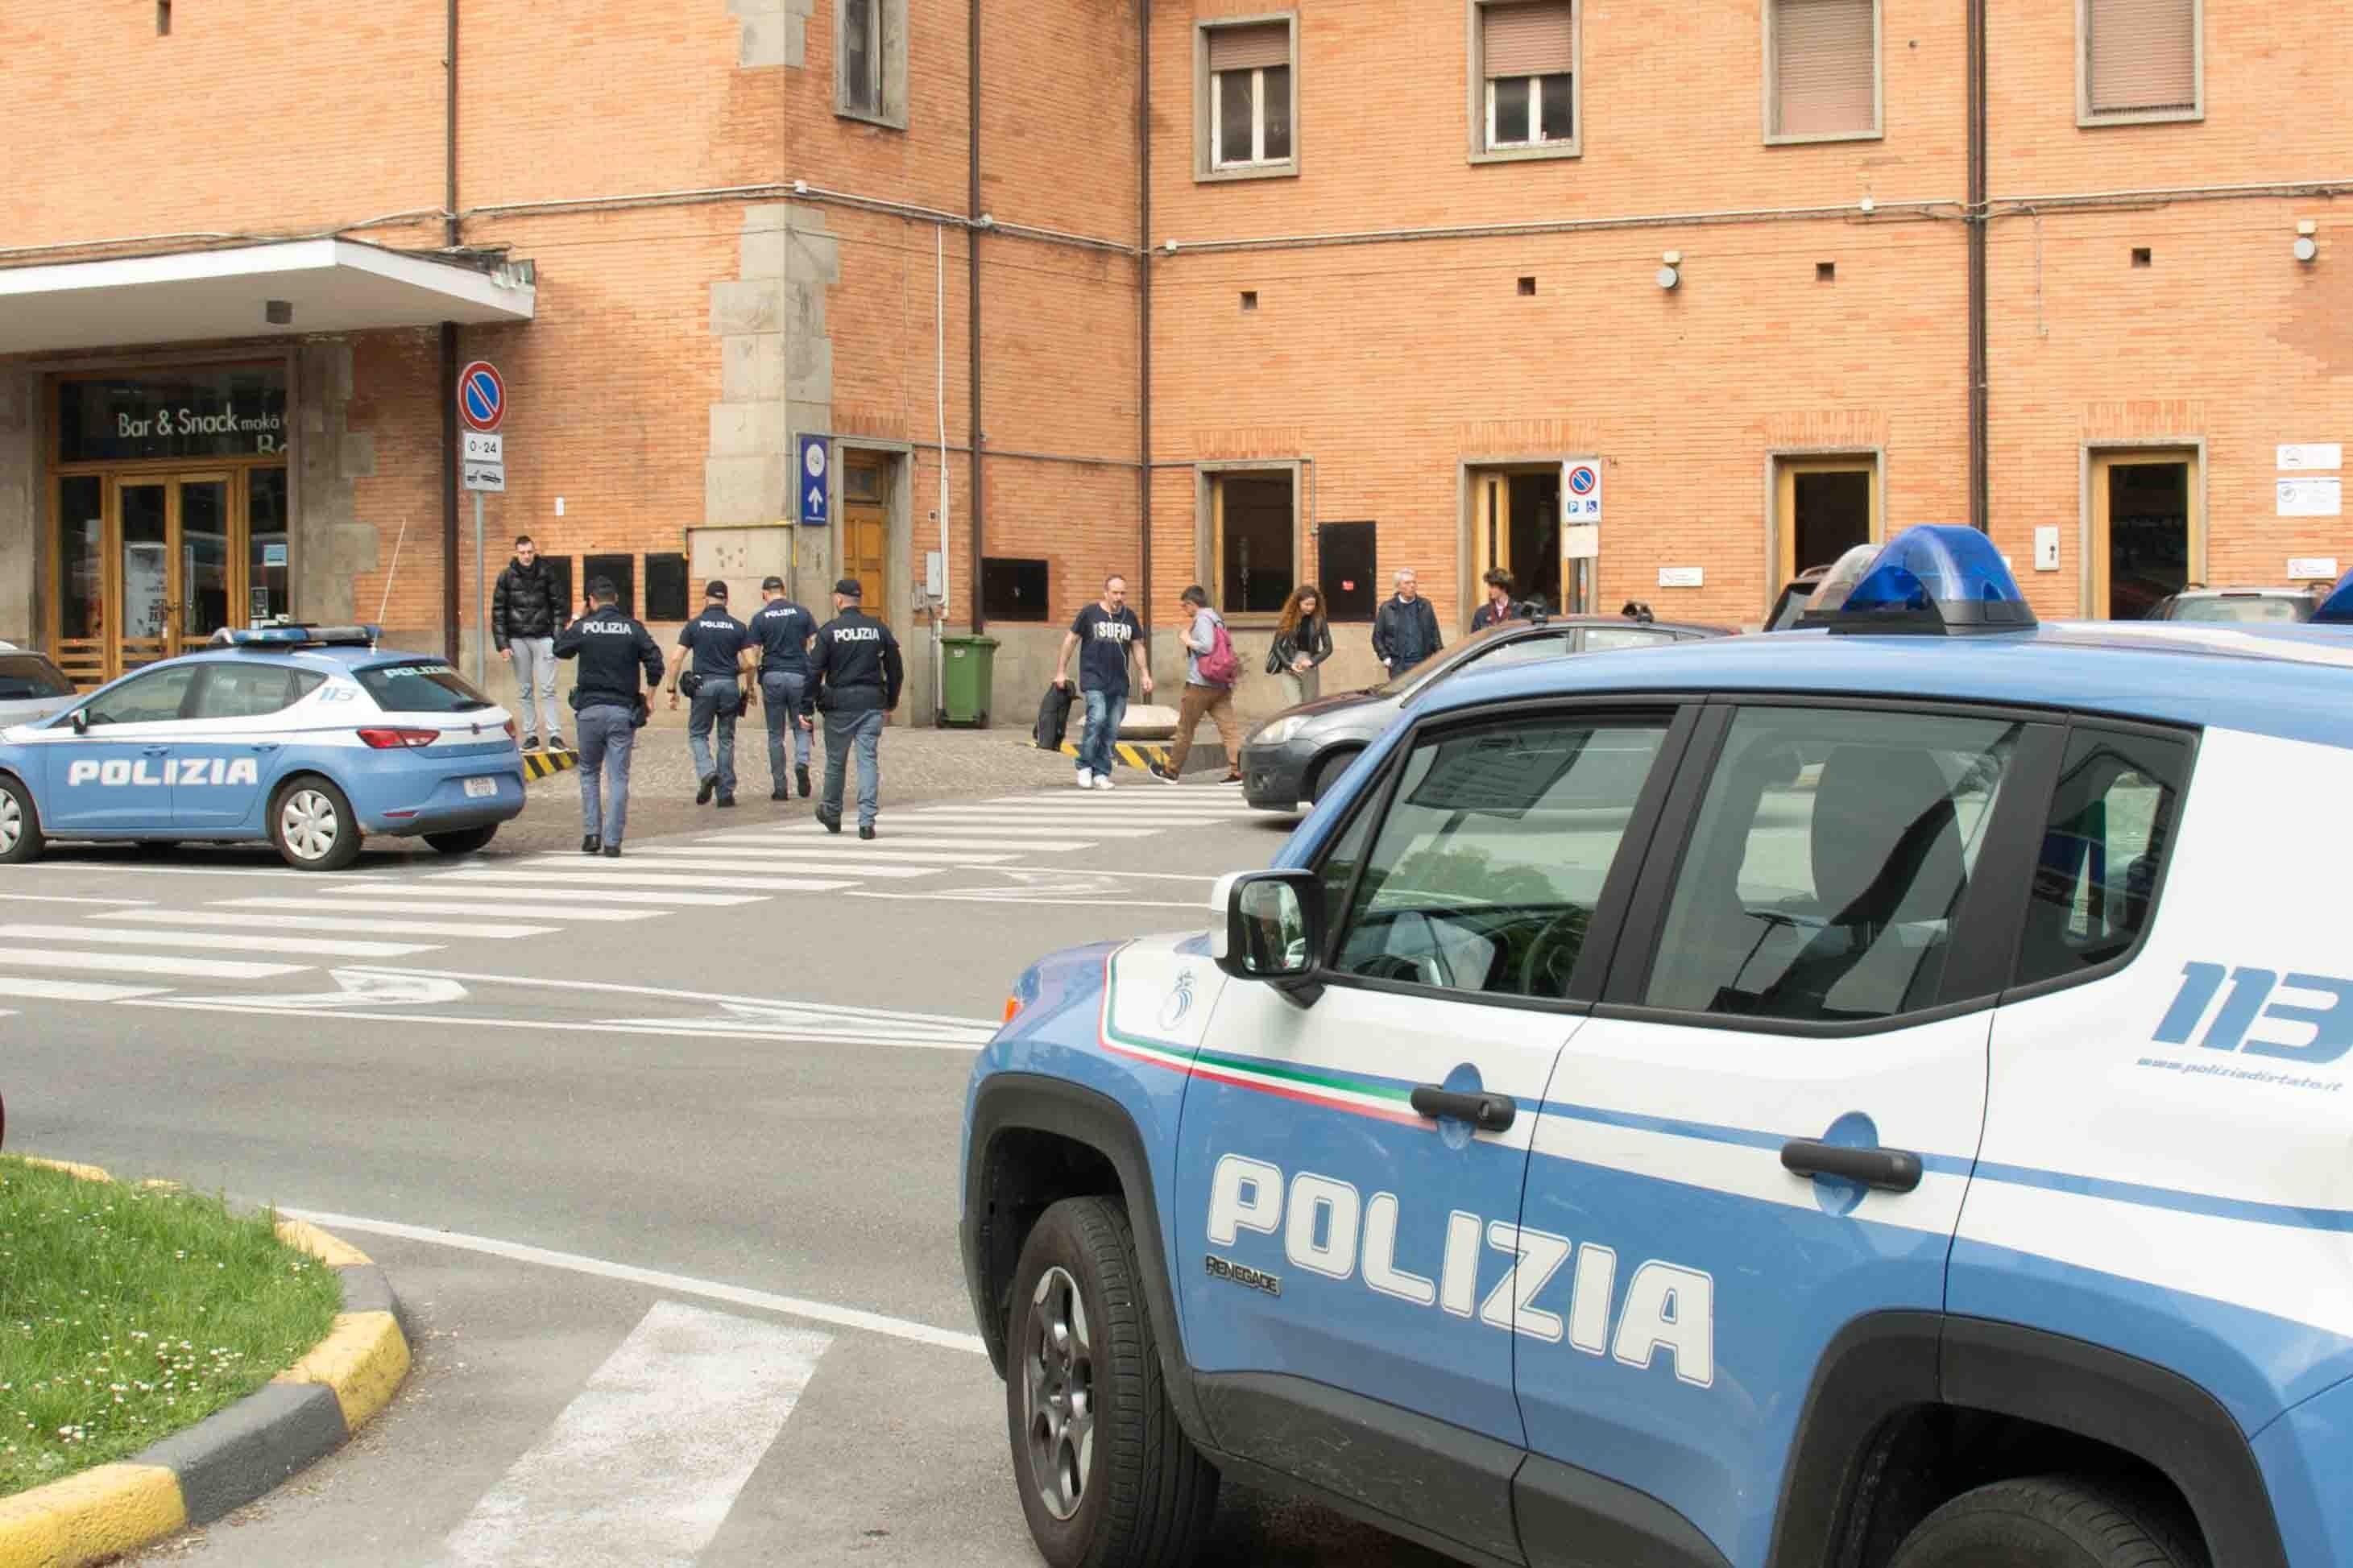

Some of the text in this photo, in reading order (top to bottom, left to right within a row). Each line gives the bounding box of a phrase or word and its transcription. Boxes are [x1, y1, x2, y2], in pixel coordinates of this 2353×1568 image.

[118, 412, 152, 437] Bar
[157, 409, 174, 436] &
[178, 402, 238, 435] Snack
[582, 620, 632, 635] POLIZIA
[700, 620, 734, 631] POLIZIA
[764, 607, 797, 619] POLIZIA
[834, 627, 880, 643] POLIZIA
[67, 757, 259, 787] POLIZIA
[2152, 961, 2353, 1064] 113
[1205, 1253, 1282, 1296] RENEGADE
[1208, 1152, 1714, 1389] POLIZIA
